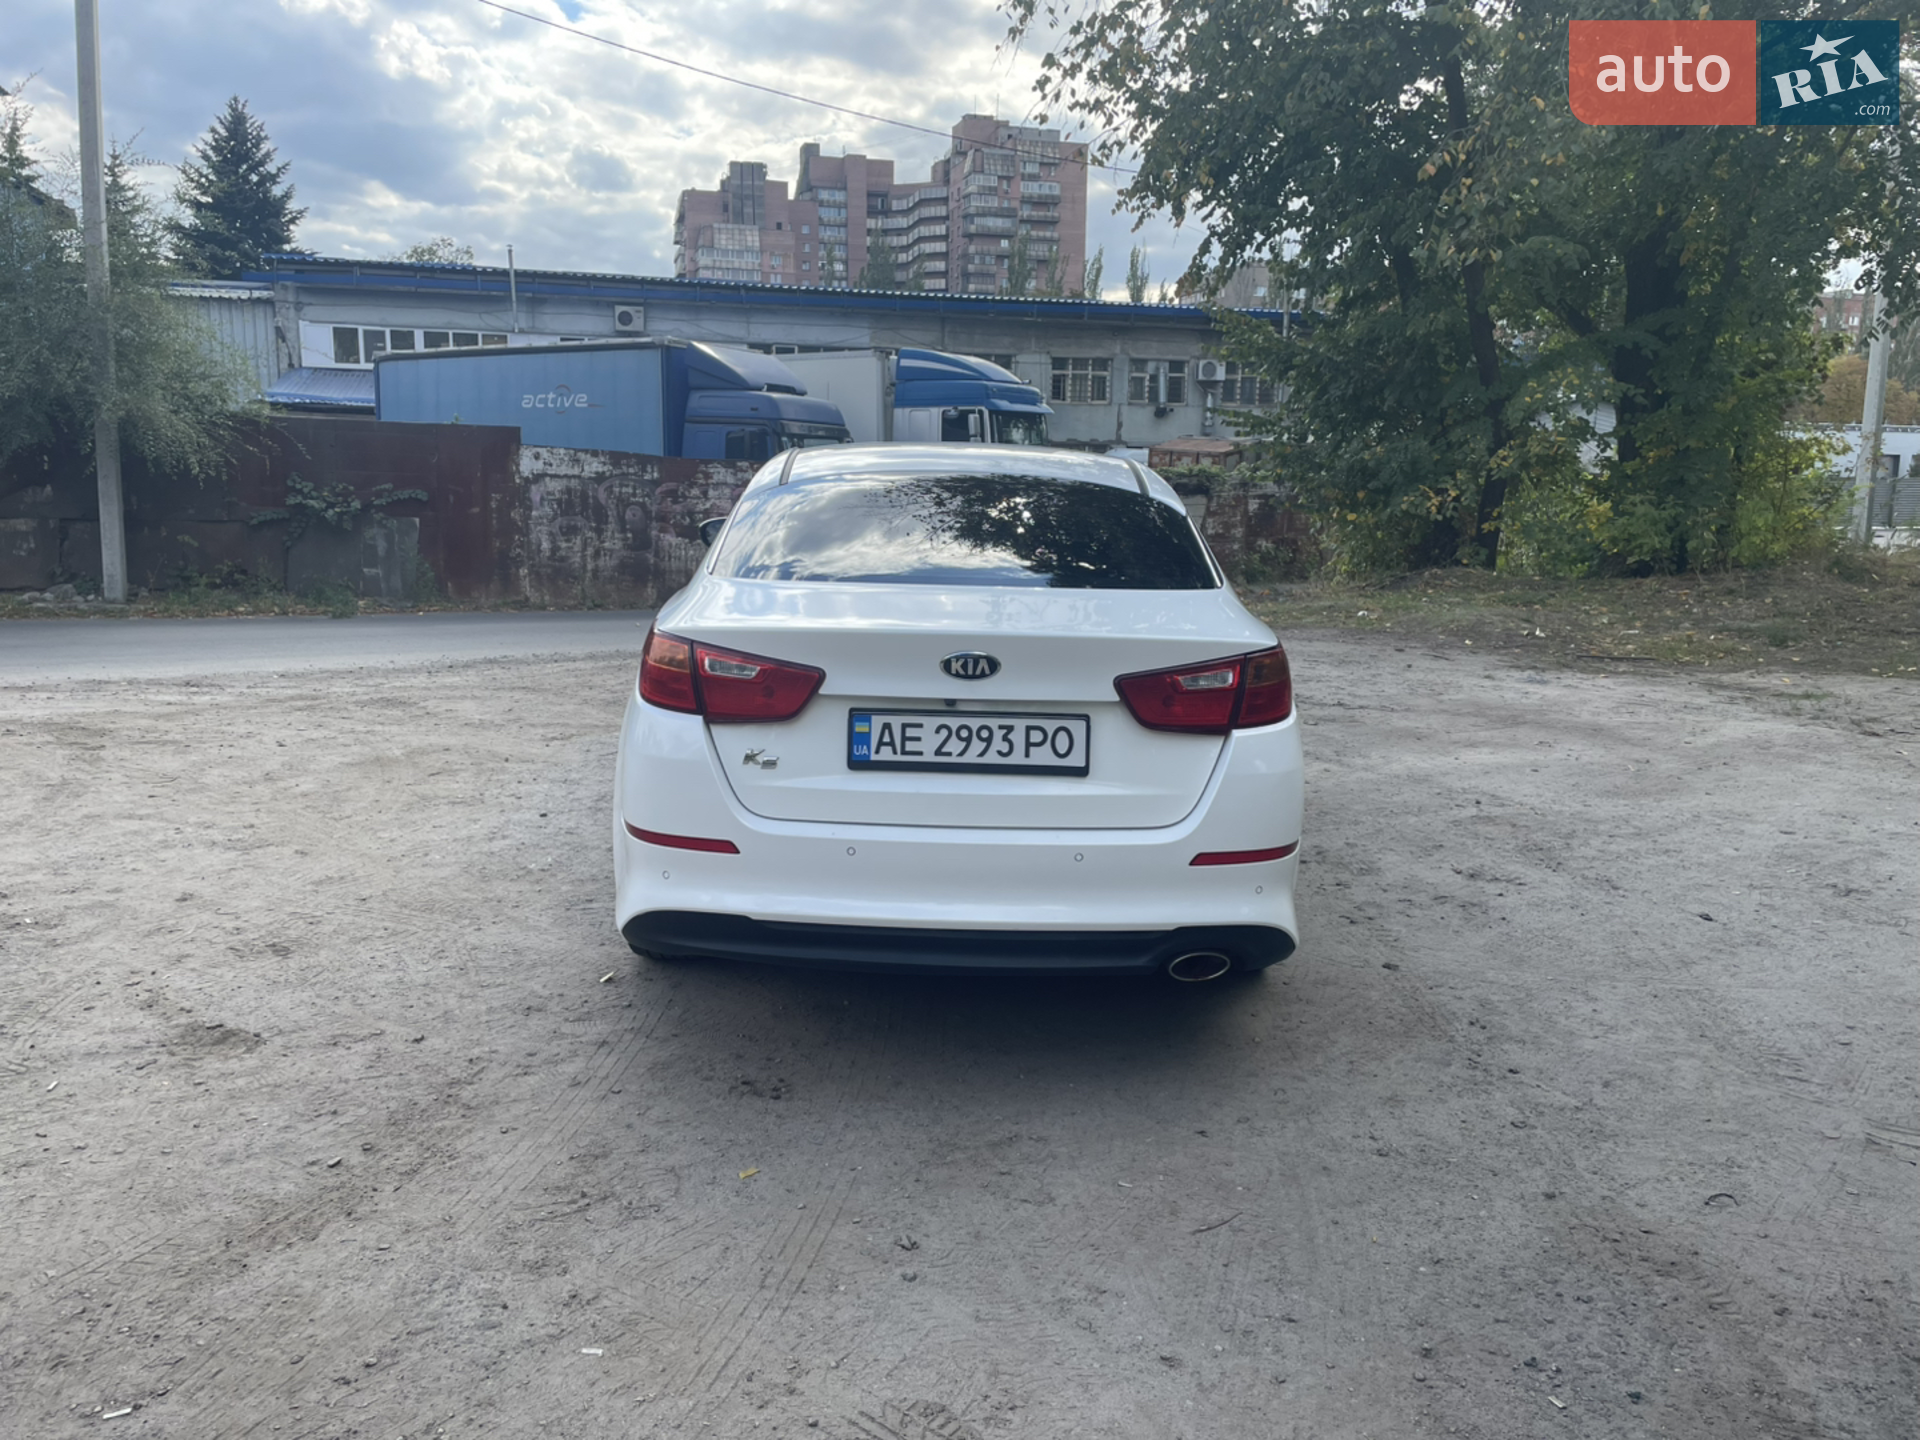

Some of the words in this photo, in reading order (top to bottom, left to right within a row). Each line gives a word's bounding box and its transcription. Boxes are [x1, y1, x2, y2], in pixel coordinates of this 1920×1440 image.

[521, 391, 589, 408] active
[950, 658, 991, 675] KIA
[874, 722, 924, 756] AE
[934, 723, 1015, 758] 2993
[1024, 724, 1075, 759] PO
[853, 744, 870, 756] UA
[742, 748, 780, 770] K5
